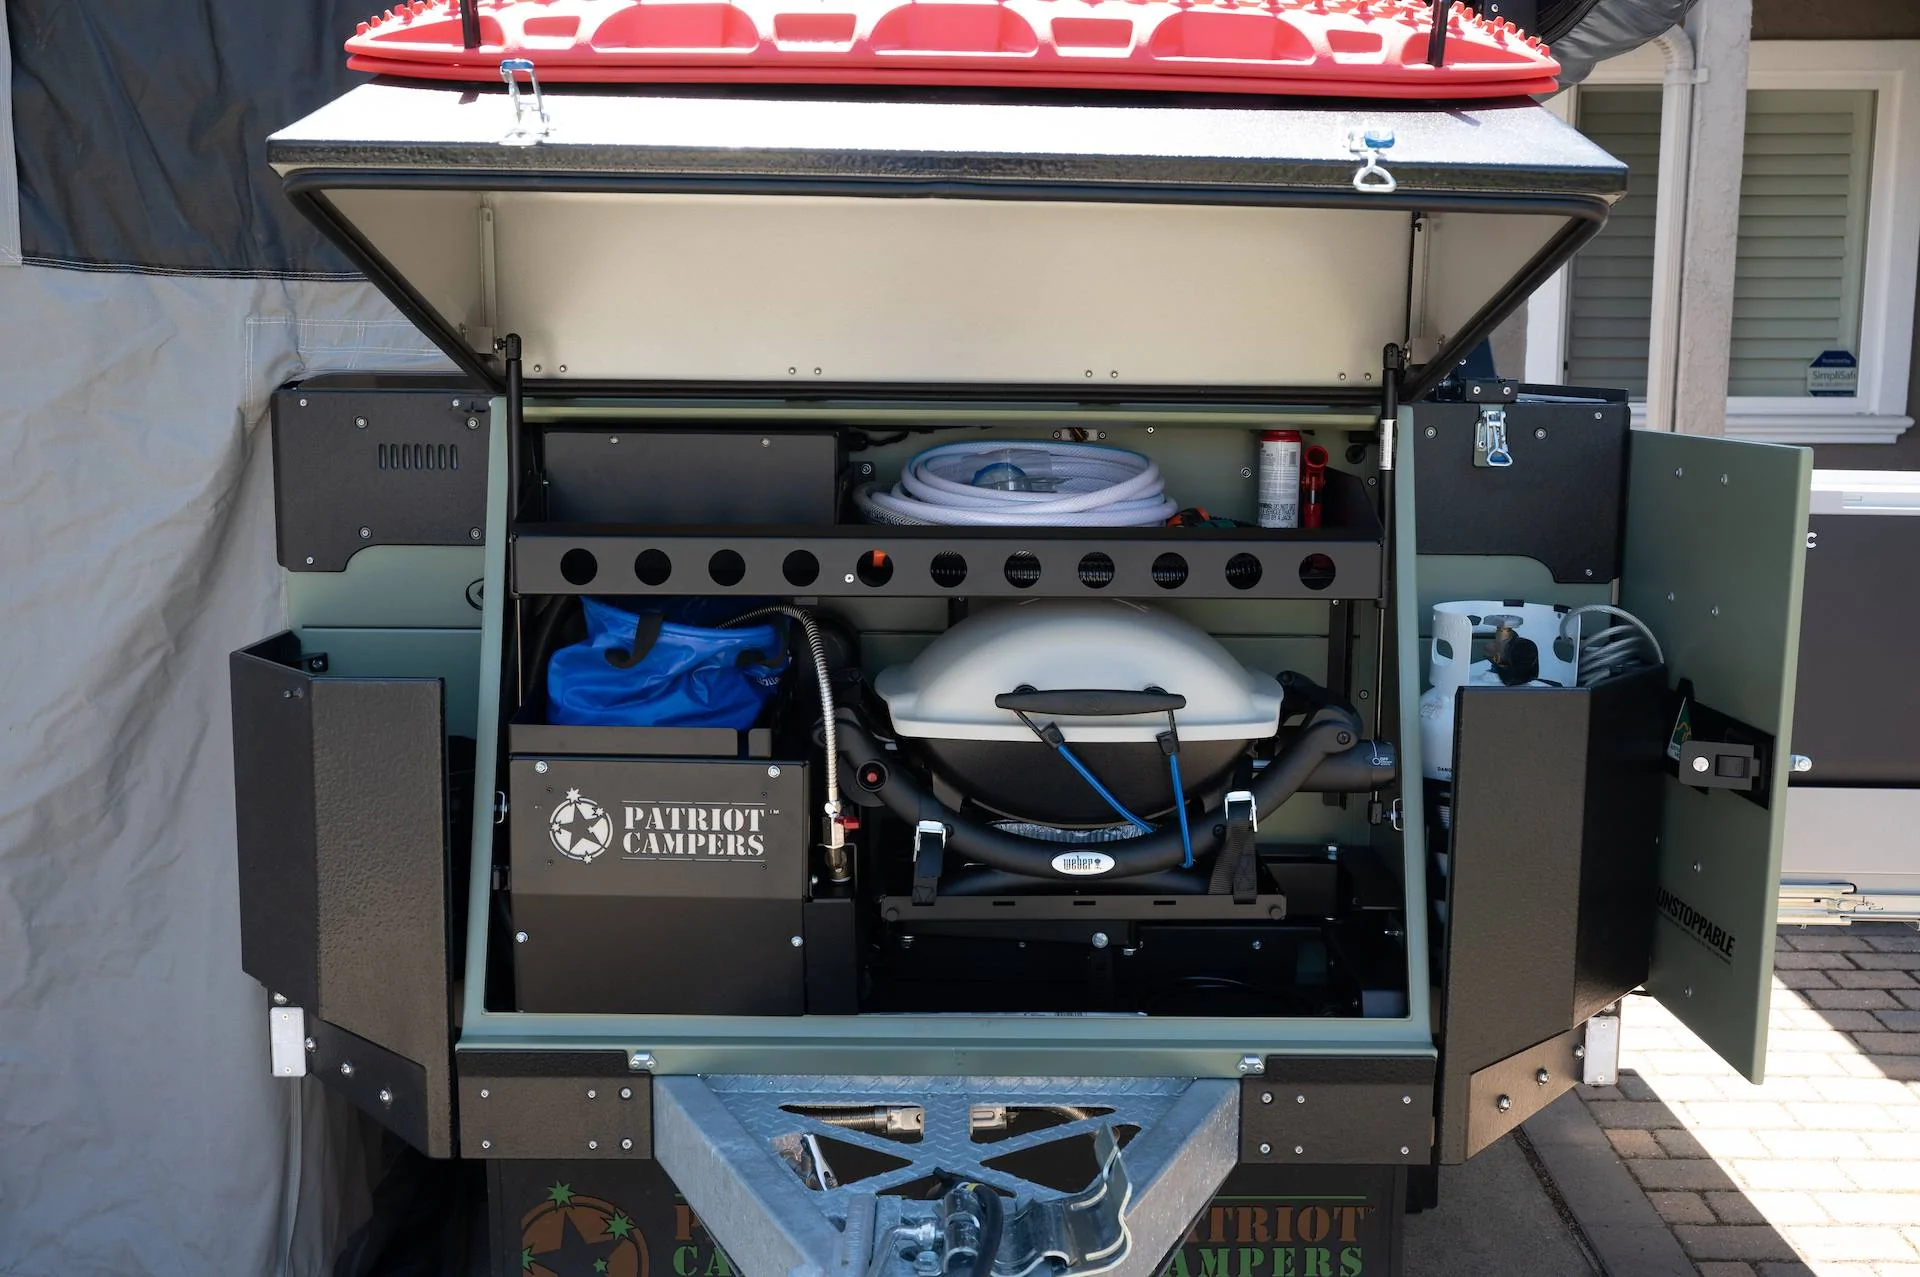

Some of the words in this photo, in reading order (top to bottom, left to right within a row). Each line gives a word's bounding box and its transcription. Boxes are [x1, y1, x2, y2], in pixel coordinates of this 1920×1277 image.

[624, 806, 765, 831] PATRIOT
[622, 832, 765, 856] CAMPERS
[1063, 855, 1093, 870] weber
[1656, 886, 1736, 957] UNSTOPPABLE
[1187, 1206, 1365, 1242] TRIOT
[1162, 1247, 1363, 1277] AMPERS
